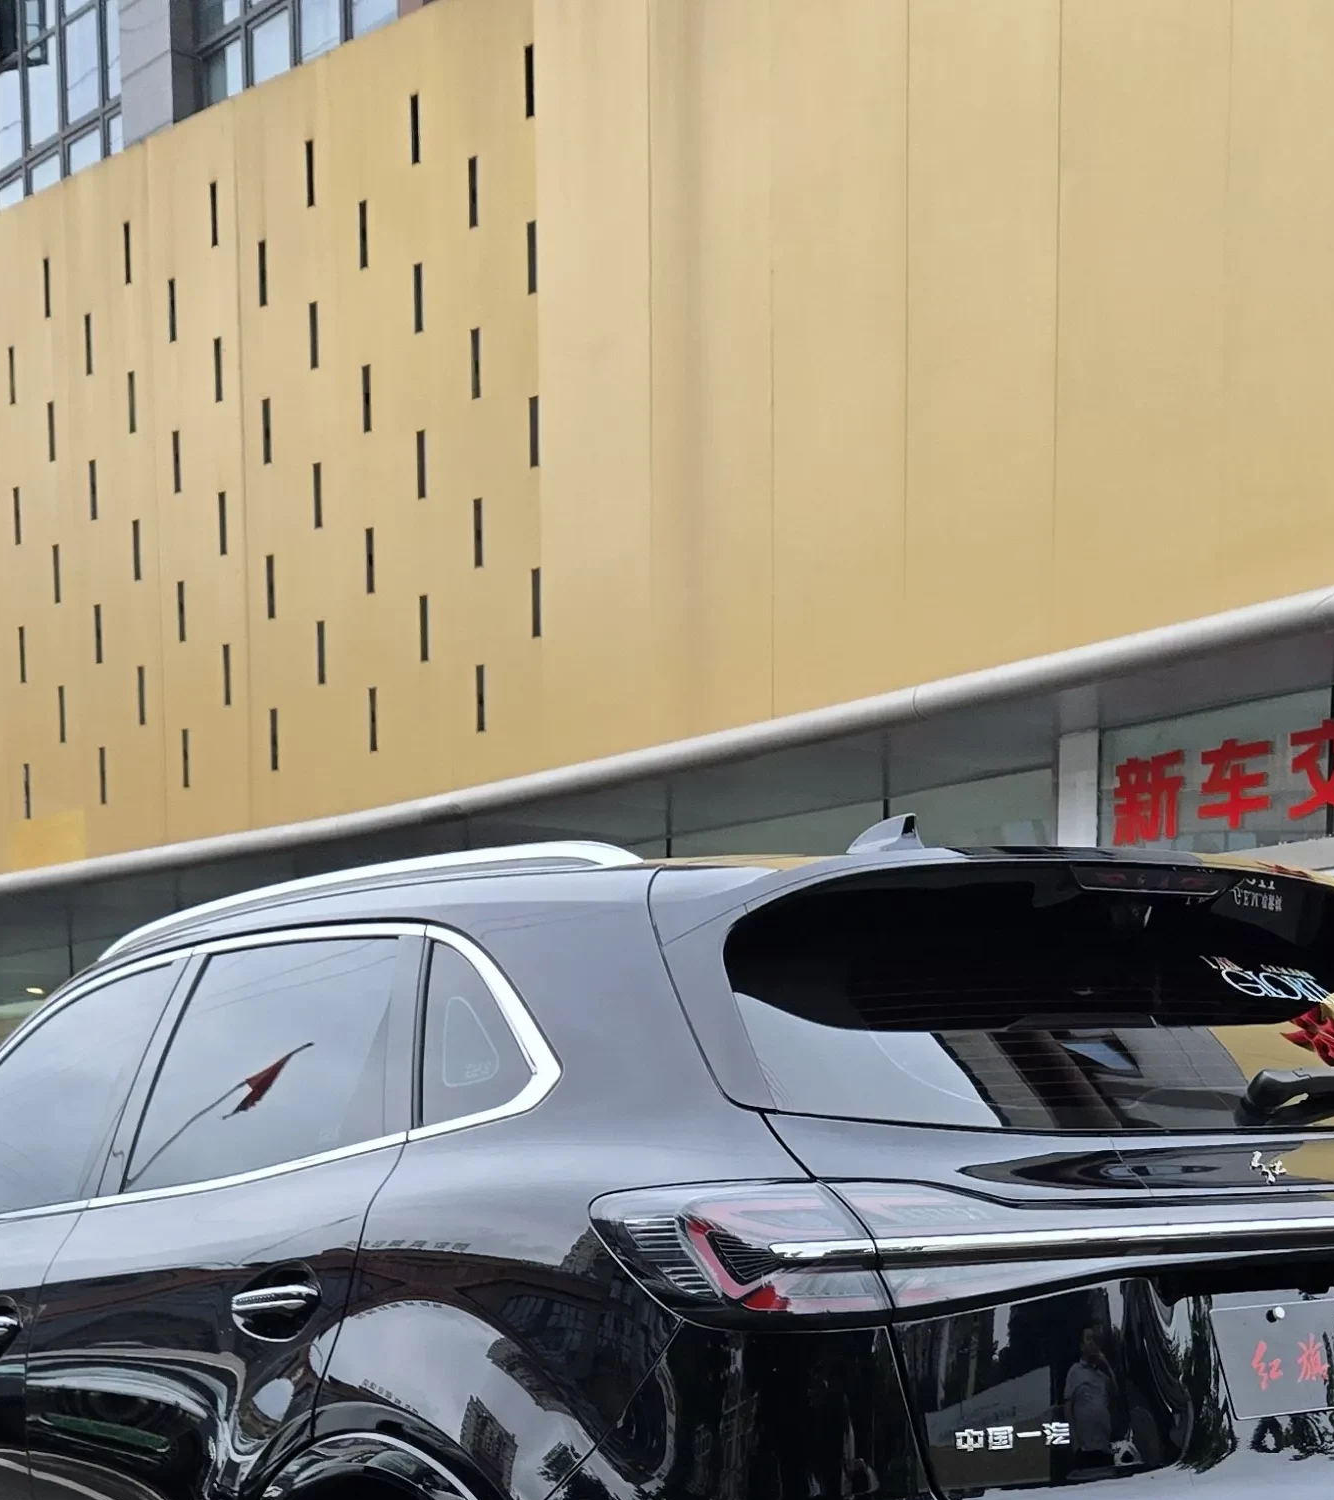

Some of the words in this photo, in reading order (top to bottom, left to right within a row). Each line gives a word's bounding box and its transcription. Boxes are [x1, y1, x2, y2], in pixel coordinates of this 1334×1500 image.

[1251, 1332, 1330, 1392] 红旗
[954, 1421, 1071, 1452] 中国一汽
